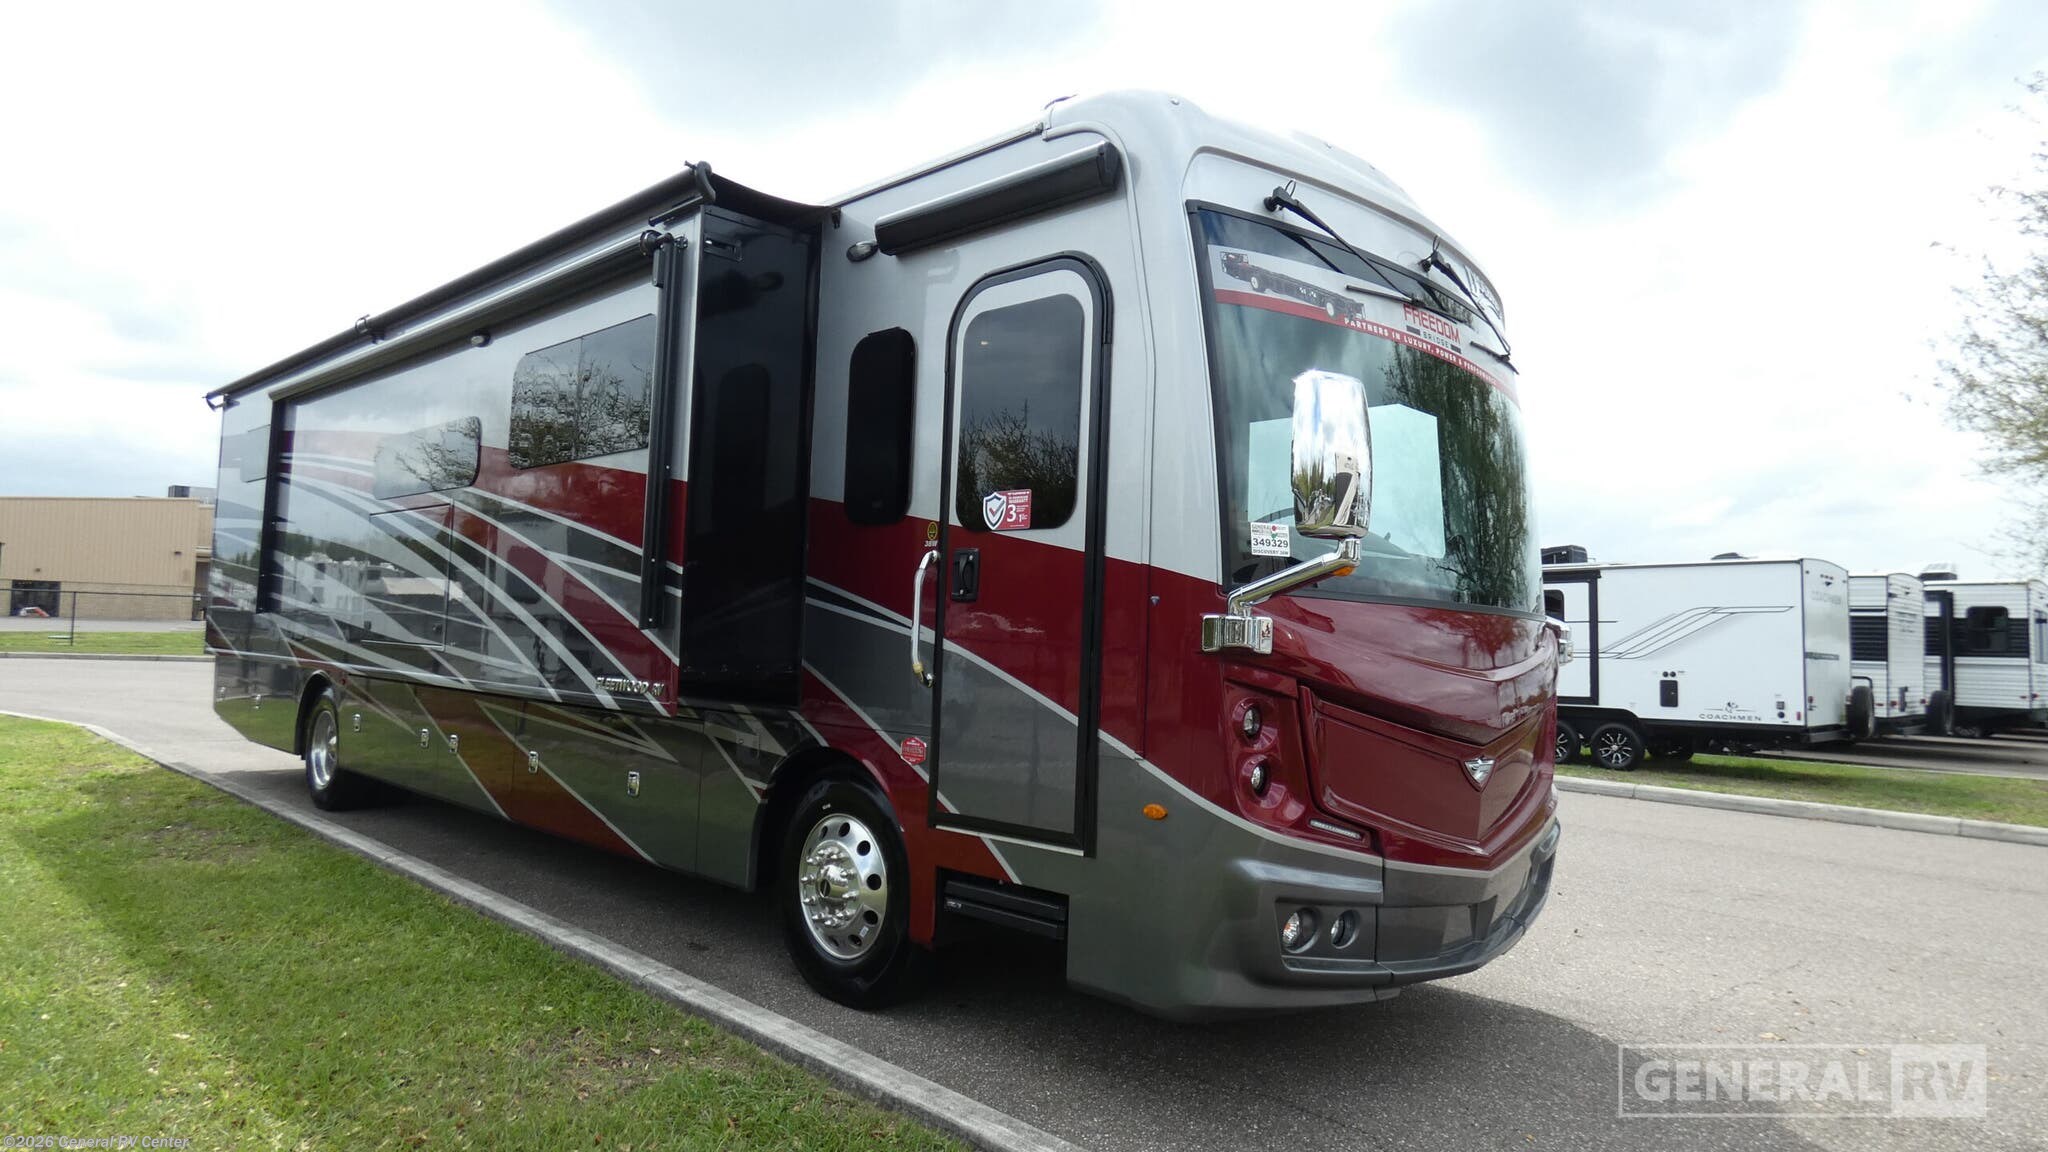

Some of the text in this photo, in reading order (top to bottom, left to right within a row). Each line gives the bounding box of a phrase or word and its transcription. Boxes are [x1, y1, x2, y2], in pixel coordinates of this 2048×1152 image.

[1344, 317, 1389, 337] PARTNERS
[1391, 331, 1401, 340] IN
[1403, 303, 1460, 344] FREEDOM
[1006, 504, 1017, 522] 3
[1252, 537, 1289, 548] 349329
[596, 677, 665, 696] FLEETWOOD RV
[1698, 713, 1762, 721] COACHMEN
